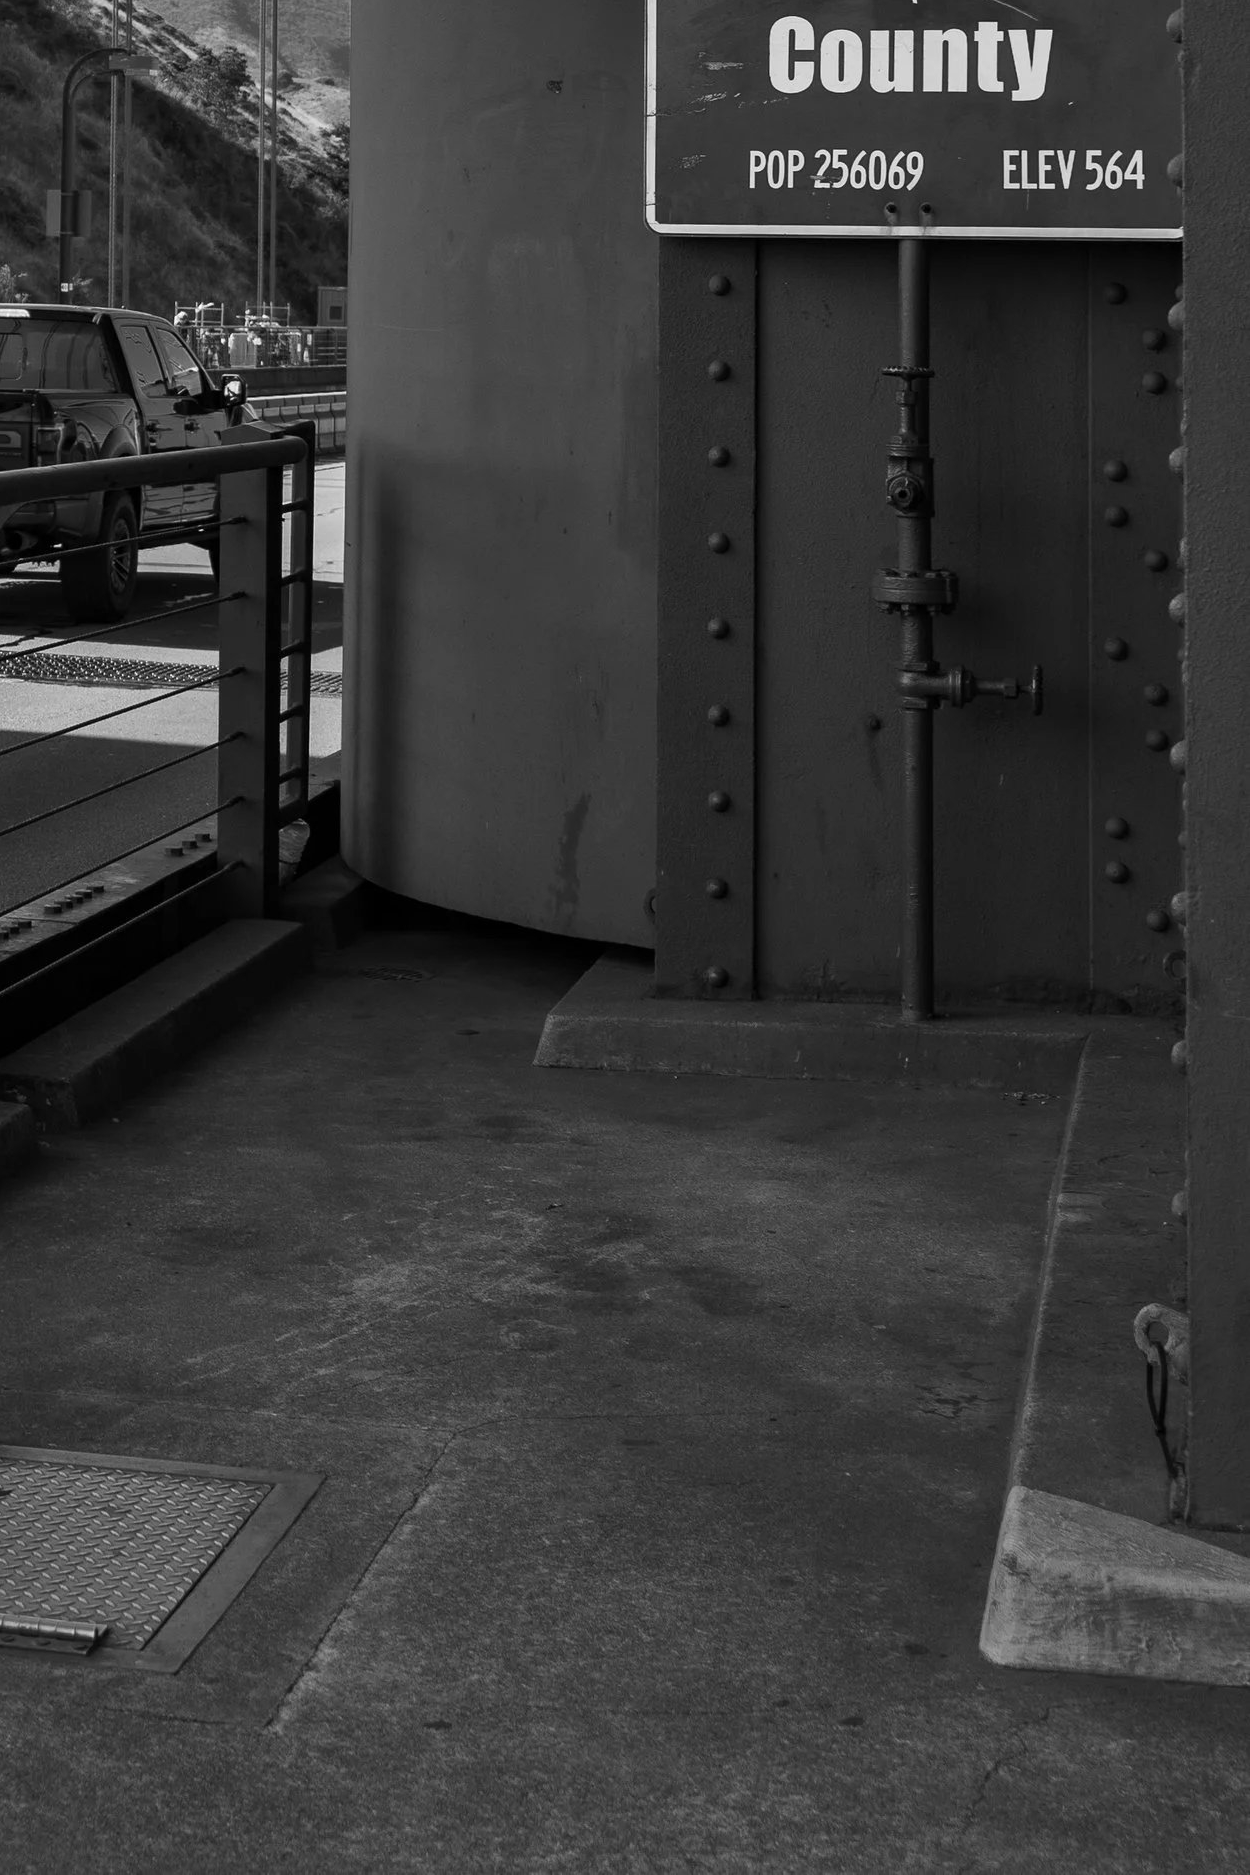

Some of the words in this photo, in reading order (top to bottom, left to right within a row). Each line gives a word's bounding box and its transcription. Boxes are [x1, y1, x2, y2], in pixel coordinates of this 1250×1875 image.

[769, 16, 1053, 101] County
[749, 149, 805, 190] POP
[813, 148, 924, 191] 256069
[1002, 149, 1077, 190] ELEV
[1085, 149, 1146, 191] 564
